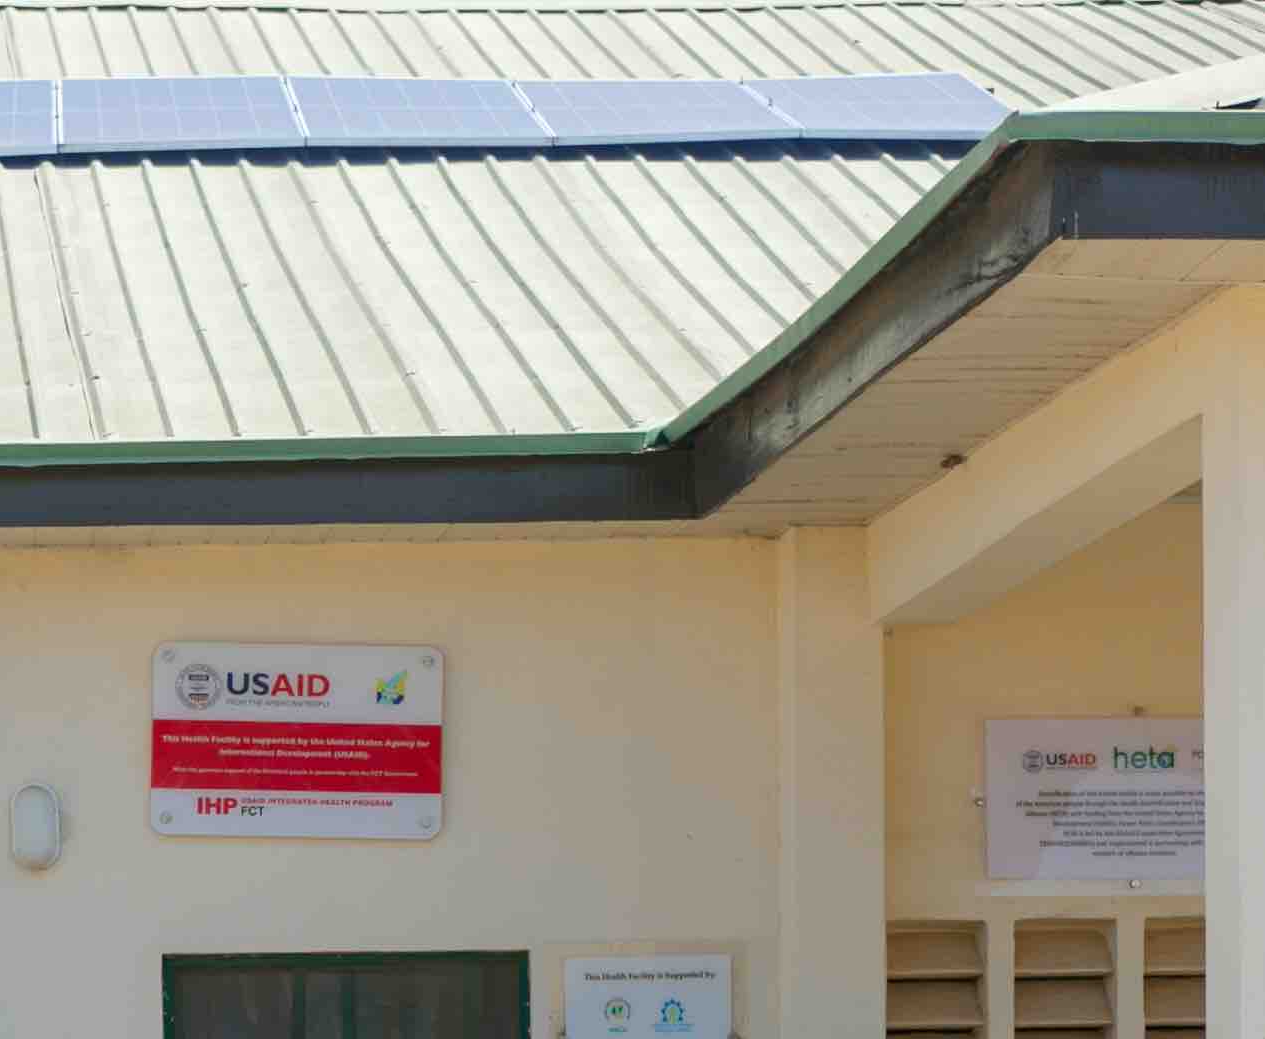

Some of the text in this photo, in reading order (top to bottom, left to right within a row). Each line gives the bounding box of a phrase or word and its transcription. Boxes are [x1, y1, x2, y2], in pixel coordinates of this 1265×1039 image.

[227, 671, 330, 697] USAID
[162, 734, 179, 743] This
[181, 735, 208, 743] Health
[1045, 752, 1096, 766] USAID
[1113, 747, 1175, 769] heta
[196, 796, 238, 815] IHP
[320, 799, 350, 807] HEALTH
[352, 799, 394, 807] PROGRAM
[240, 806, 265, 816] FCT
